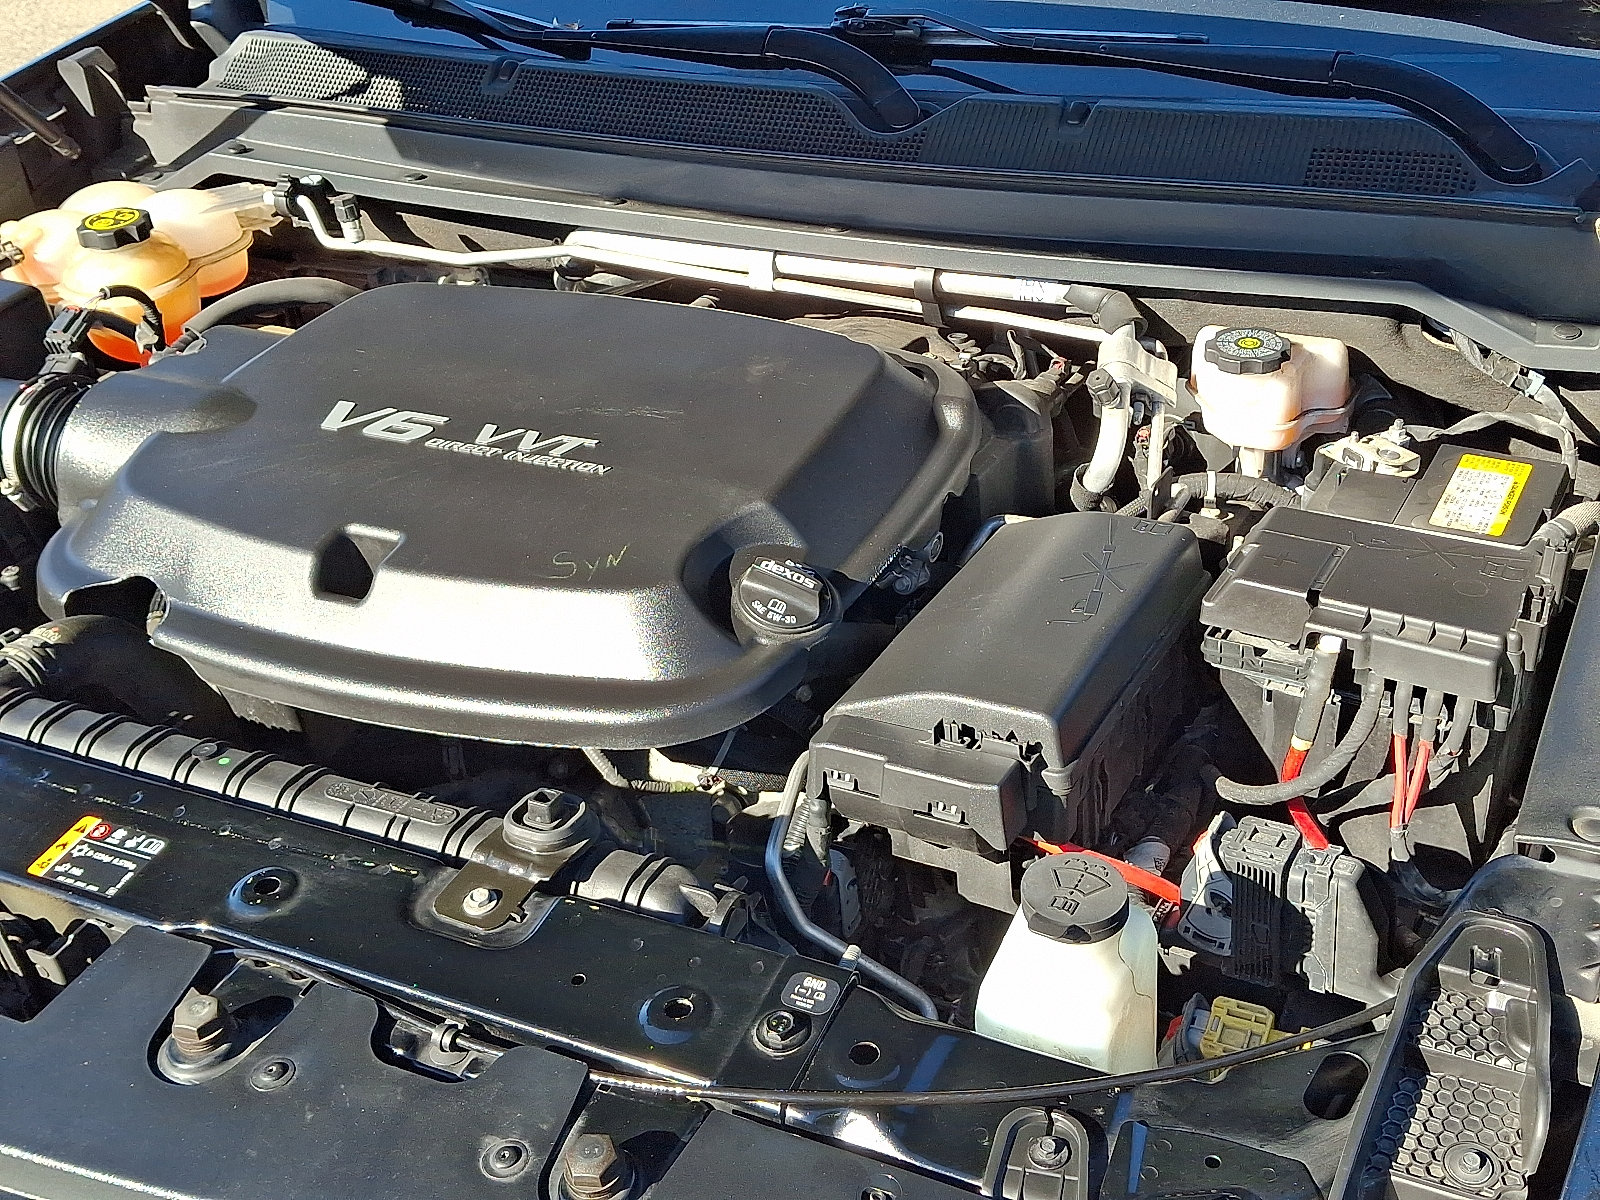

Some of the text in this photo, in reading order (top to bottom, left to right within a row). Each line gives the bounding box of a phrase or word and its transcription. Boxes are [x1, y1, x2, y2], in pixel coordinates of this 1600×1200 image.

[320, 399, 601, 457] V6 VVT
[424, 437, 614, 475] DIRECT INJECTION
[760, 560, 816, 588] dexos
[751, 600, 767, 614] SAE
[803, 976, 827, 991] GND
